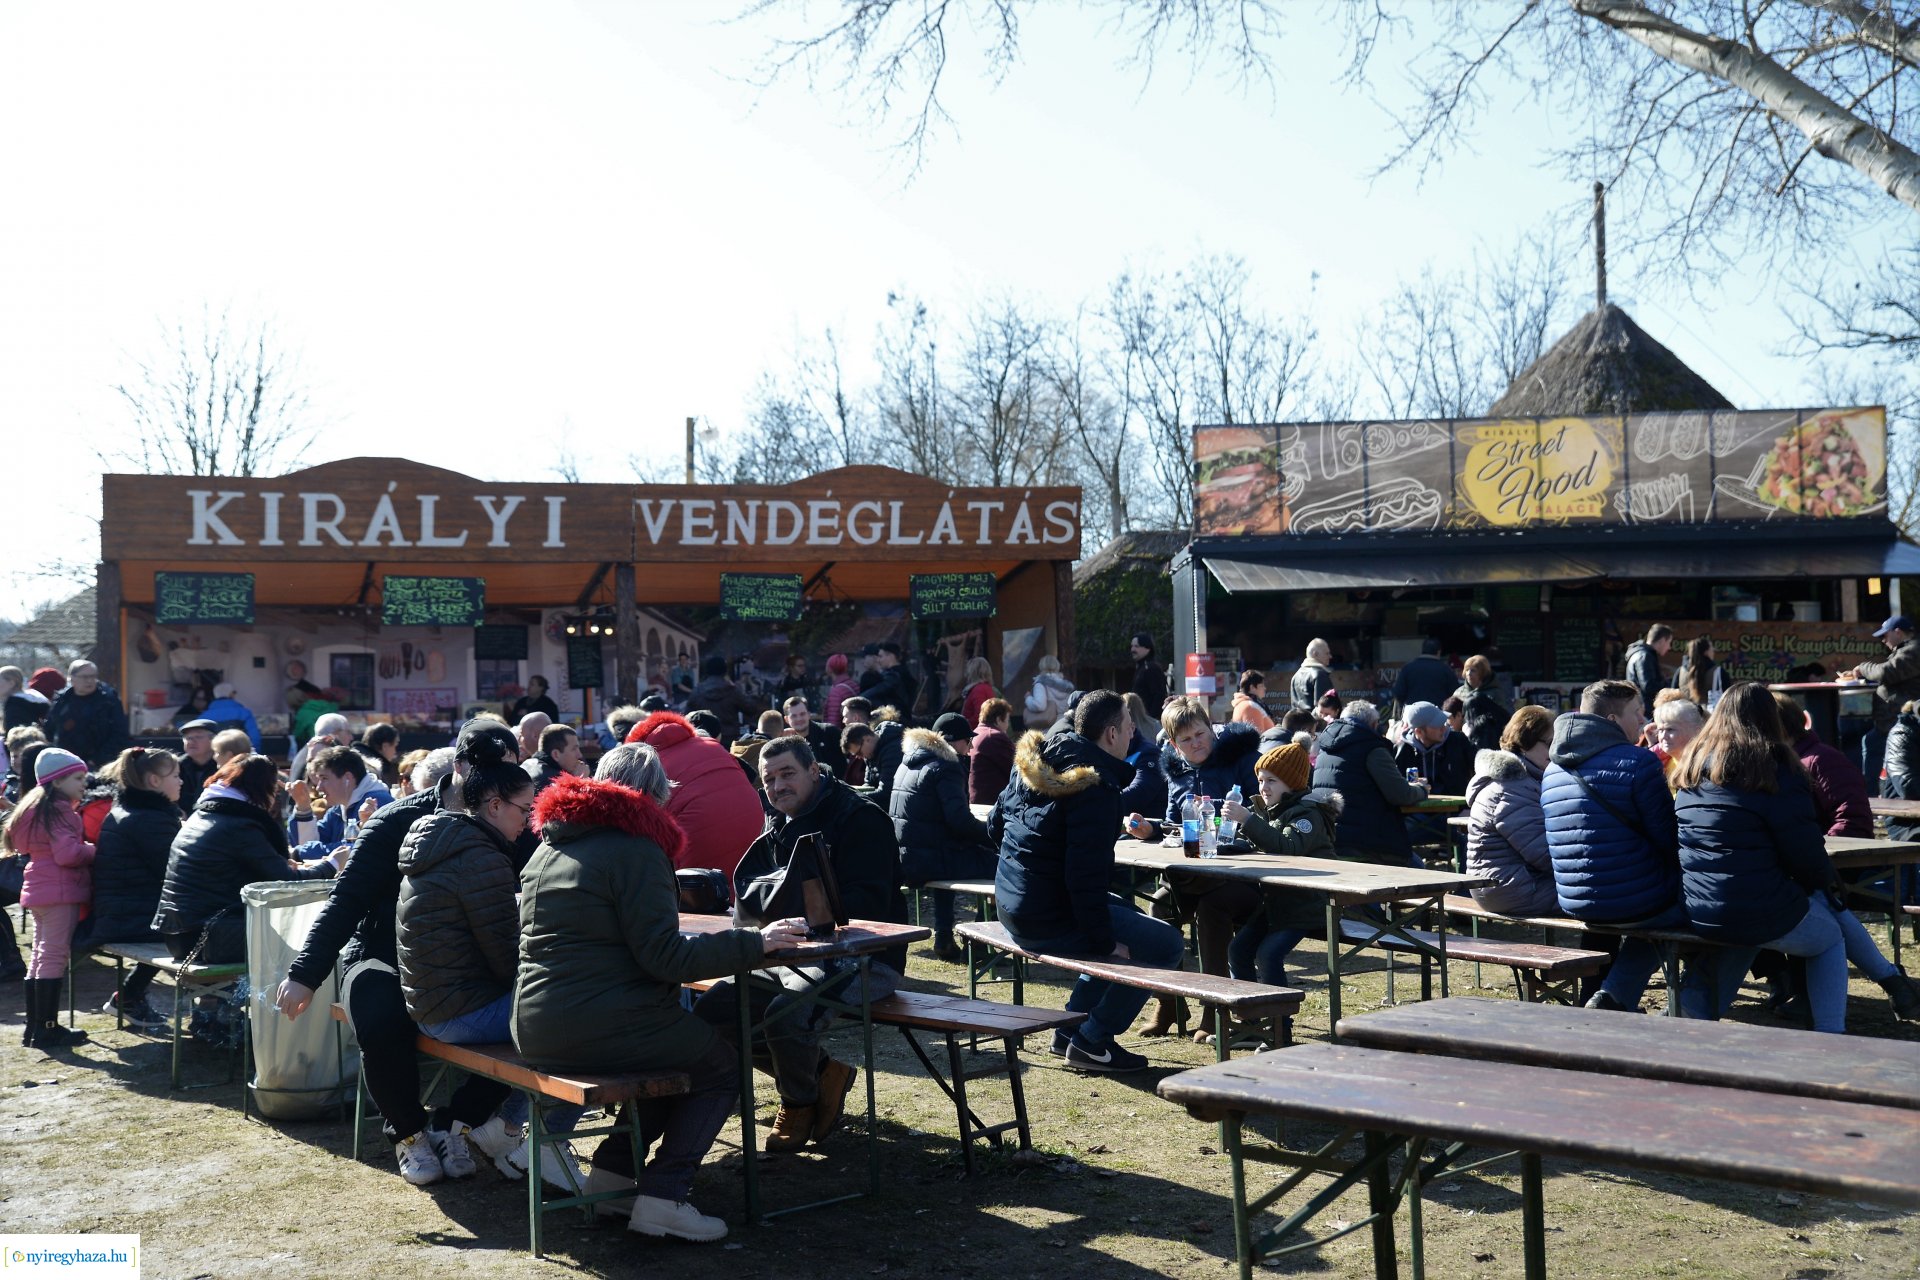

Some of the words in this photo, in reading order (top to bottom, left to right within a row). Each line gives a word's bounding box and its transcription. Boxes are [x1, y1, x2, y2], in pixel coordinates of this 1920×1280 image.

[1477, 425, 1576, 481] Street
[1497, 449, 1598, 518] Food
[186, 480, 567, 548] KIRÁLYI
[635, 489, 1078, 546] VENDÉGLÁTÁS
[1536, 504, 1596, 514] PALACE
[950, 600, 989, 611] OLDALAS
[1740, 634, 1776, 653] Sült
